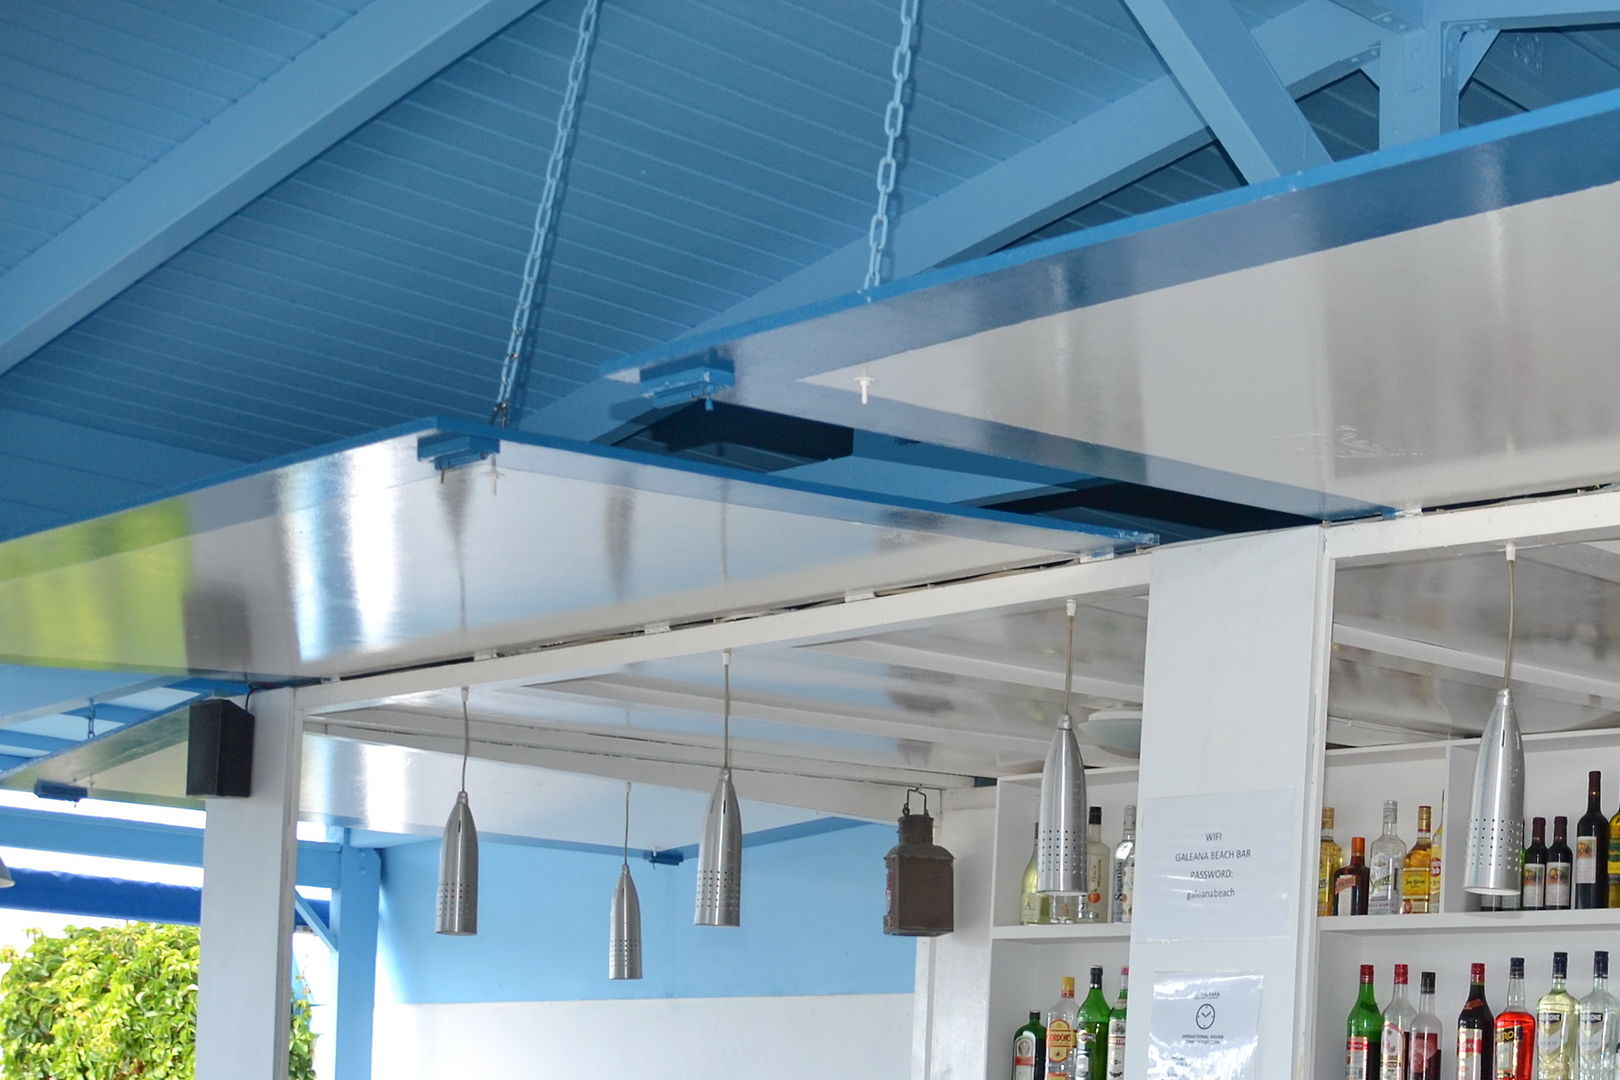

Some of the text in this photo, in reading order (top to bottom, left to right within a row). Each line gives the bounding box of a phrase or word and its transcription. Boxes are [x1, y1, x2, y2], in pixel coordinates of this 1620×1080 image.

[1205, 832, 1222, 841] WIFI
[1175, 849, 1251, 862] GALEANA BEACH BAR
[1186, 888, 1235, 901] galeanabeach
